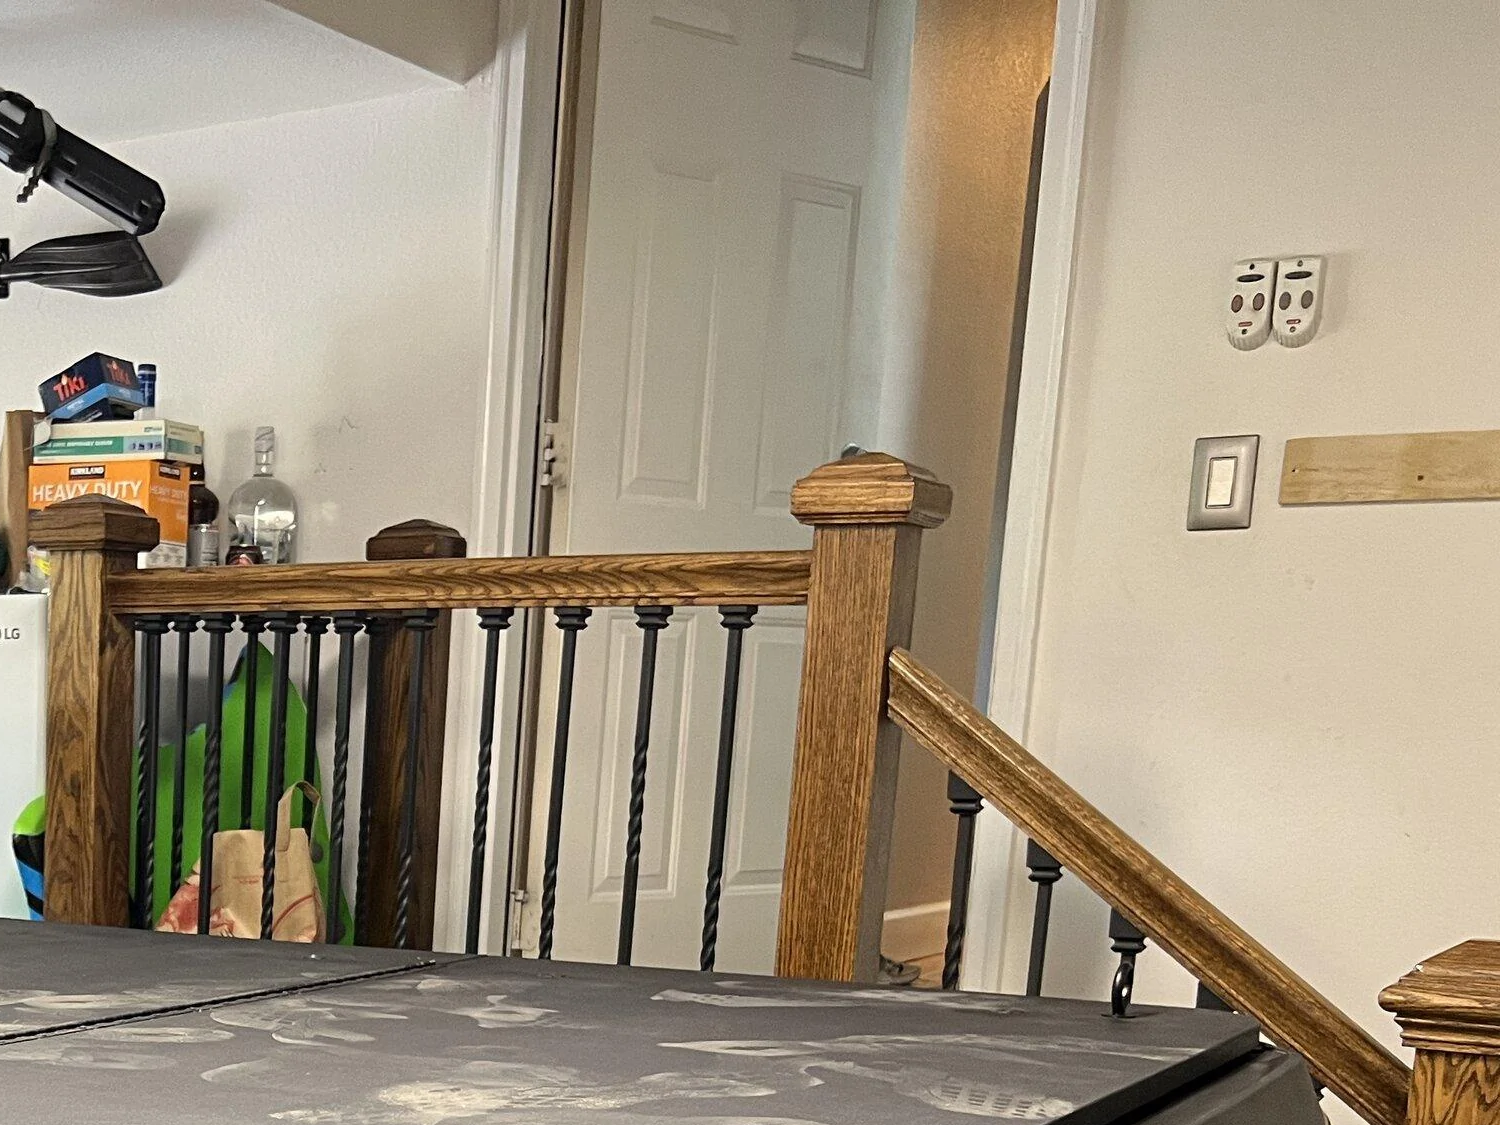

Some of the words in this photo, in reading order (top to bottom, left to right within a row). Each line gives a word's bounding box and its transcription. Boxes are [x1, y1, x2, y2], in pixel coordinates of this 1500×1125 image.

[33, 481, 90, 502] HEAVY
[94, 480, 143, 499] DUTY
[3, 627, 21, 640] LG
